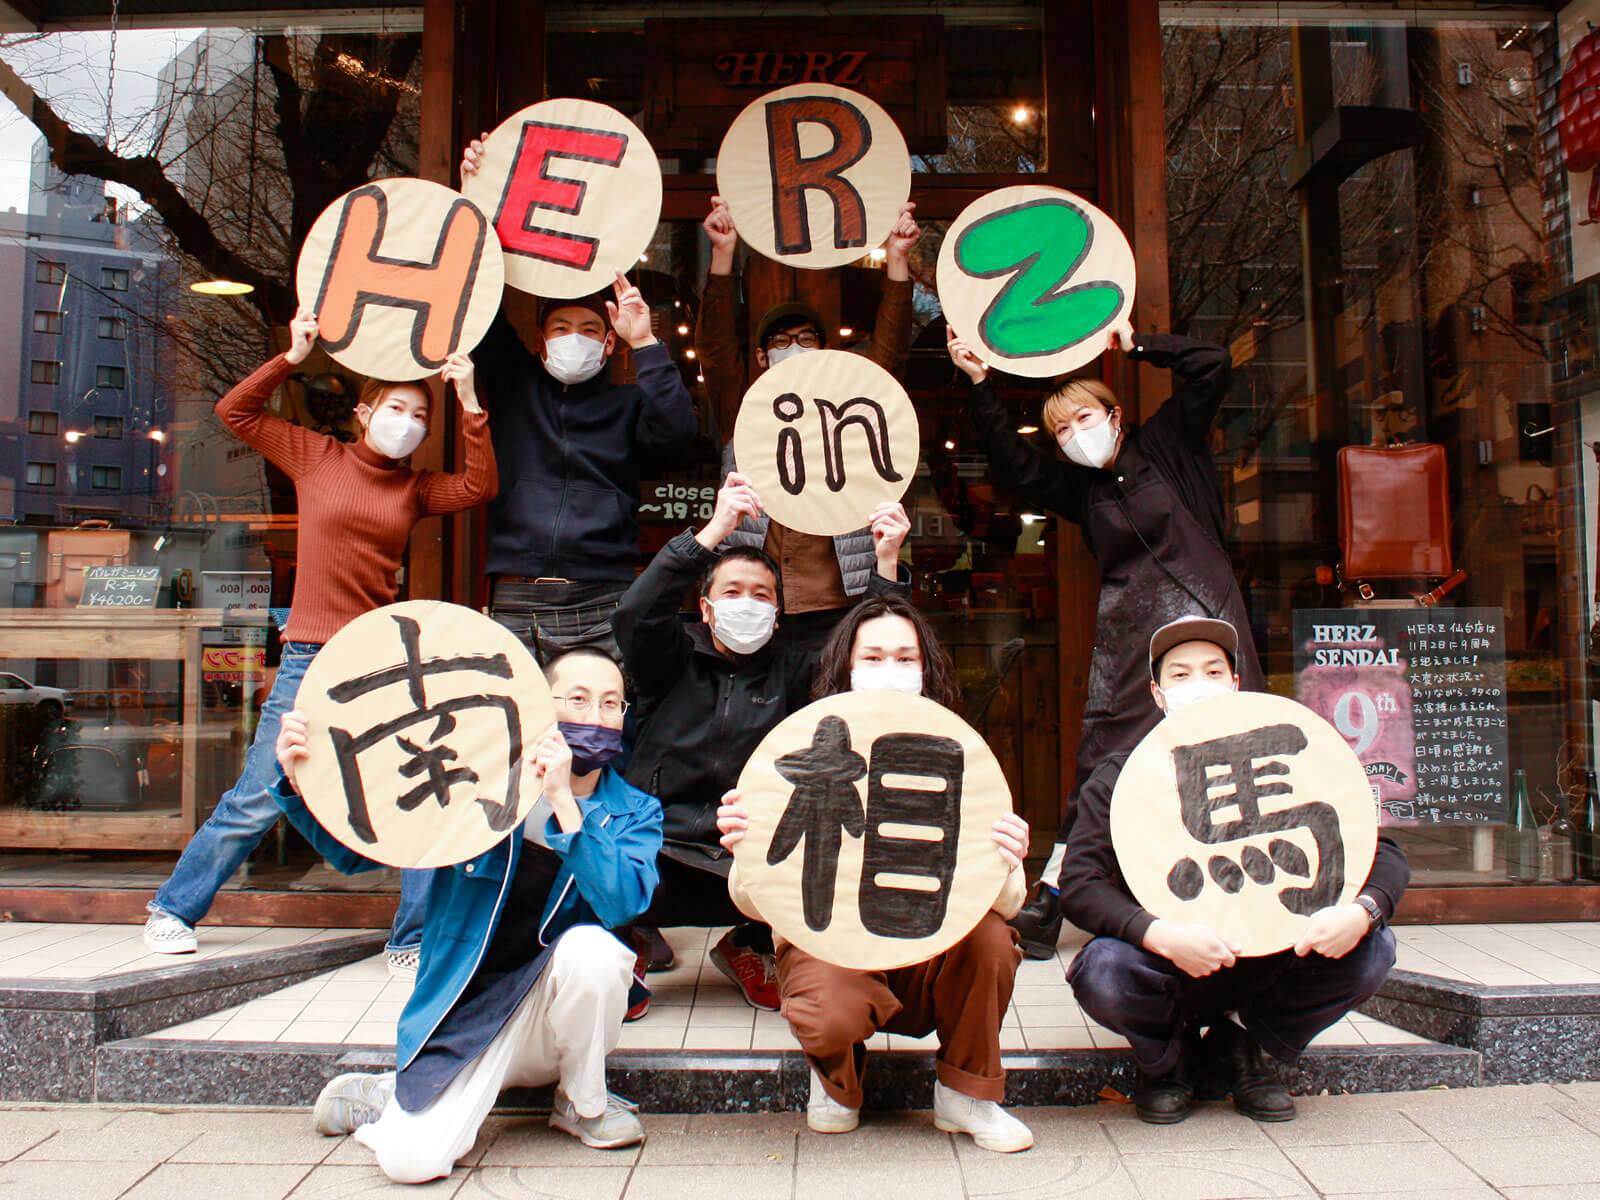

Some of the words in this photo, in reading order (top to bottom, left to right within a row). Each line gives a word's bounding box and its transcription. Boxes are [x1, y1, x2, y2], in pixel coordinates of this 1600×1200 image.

[714, 50, 869, 85] HERZ
[492, 120, 628, 271] E
[765, 95, 872, 256] R
[314, 184, 487, 369] H
[773, 392, 904, 496] in
[104, 579, 137, 592] R-24
[1312, 624, 1377, 643] HERZ
[1314, 648, 1400, 667] SENDAI
[327, 614, 524, 845] 南
[766, 715, 965, 939] 相
[1166, 723, 1345, 916] 馬
